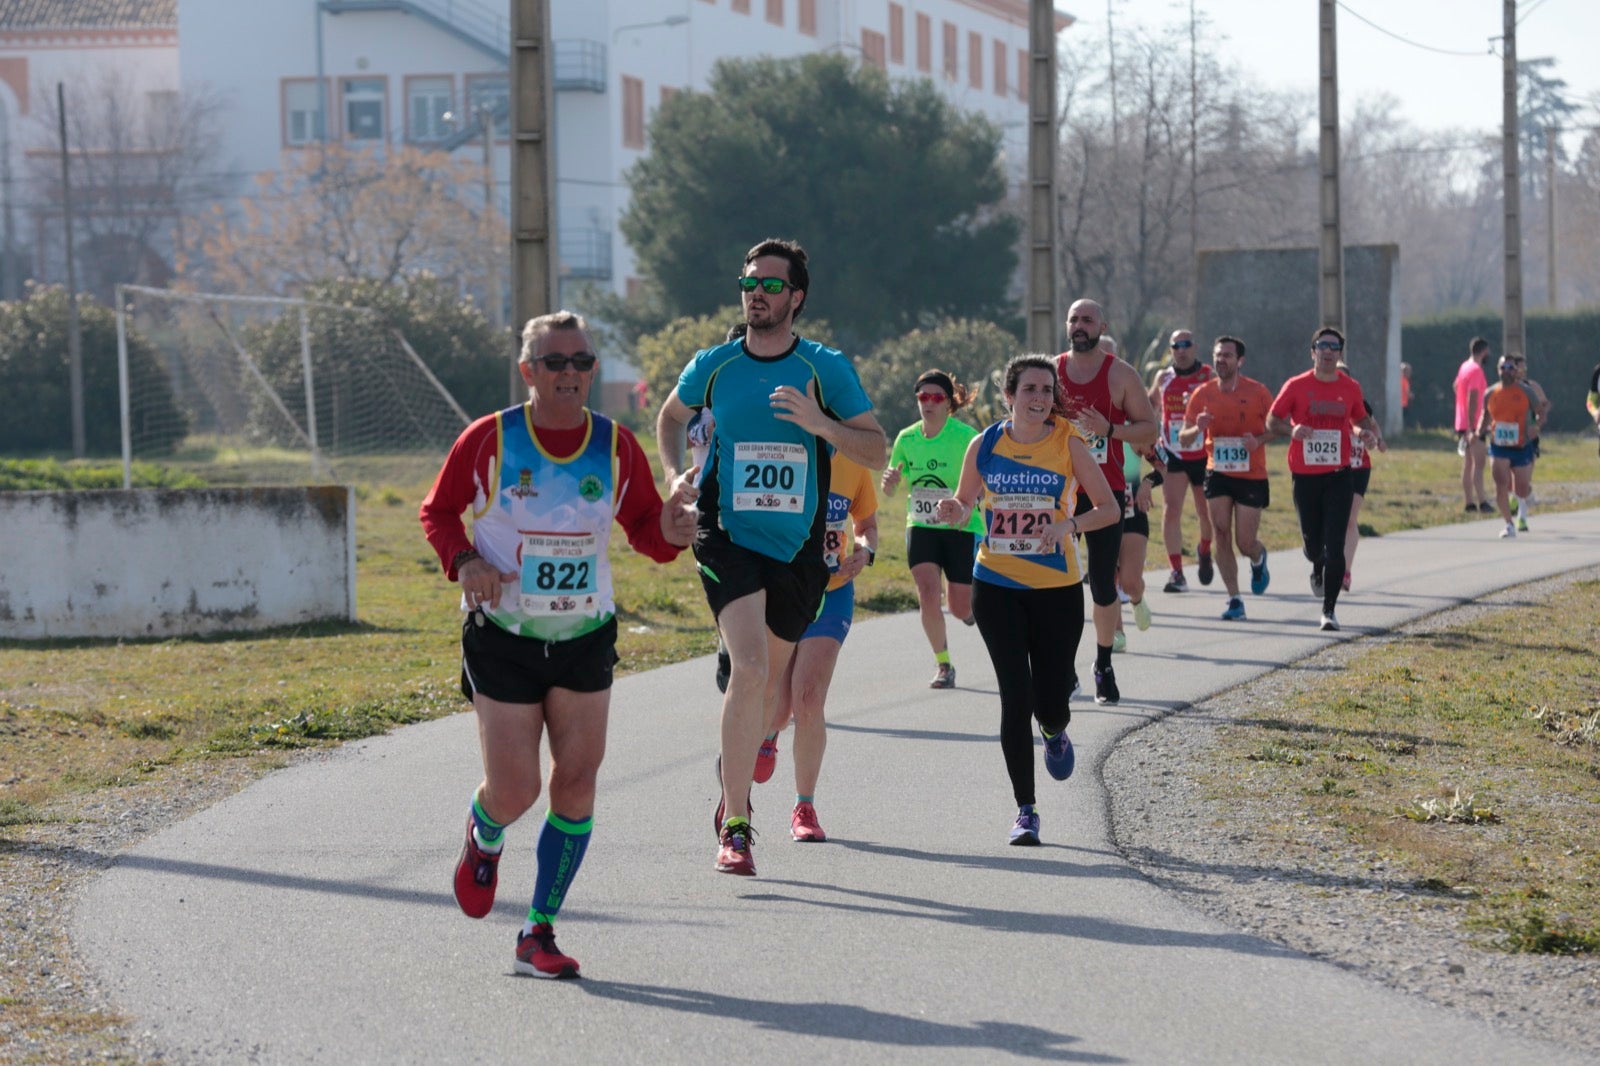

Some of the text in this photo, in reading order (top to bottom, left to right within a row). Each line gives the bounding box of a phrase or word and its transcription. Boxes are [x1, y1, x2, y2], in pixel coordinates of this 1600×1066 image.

[1216, 448, 1248, 461] 1139
[1307, 442, 1337, 453] 3025
[744, 463, 794, 490] 200
[987, 470, 1059, 487] agustinos
[536, 561, 589, 590] 822
